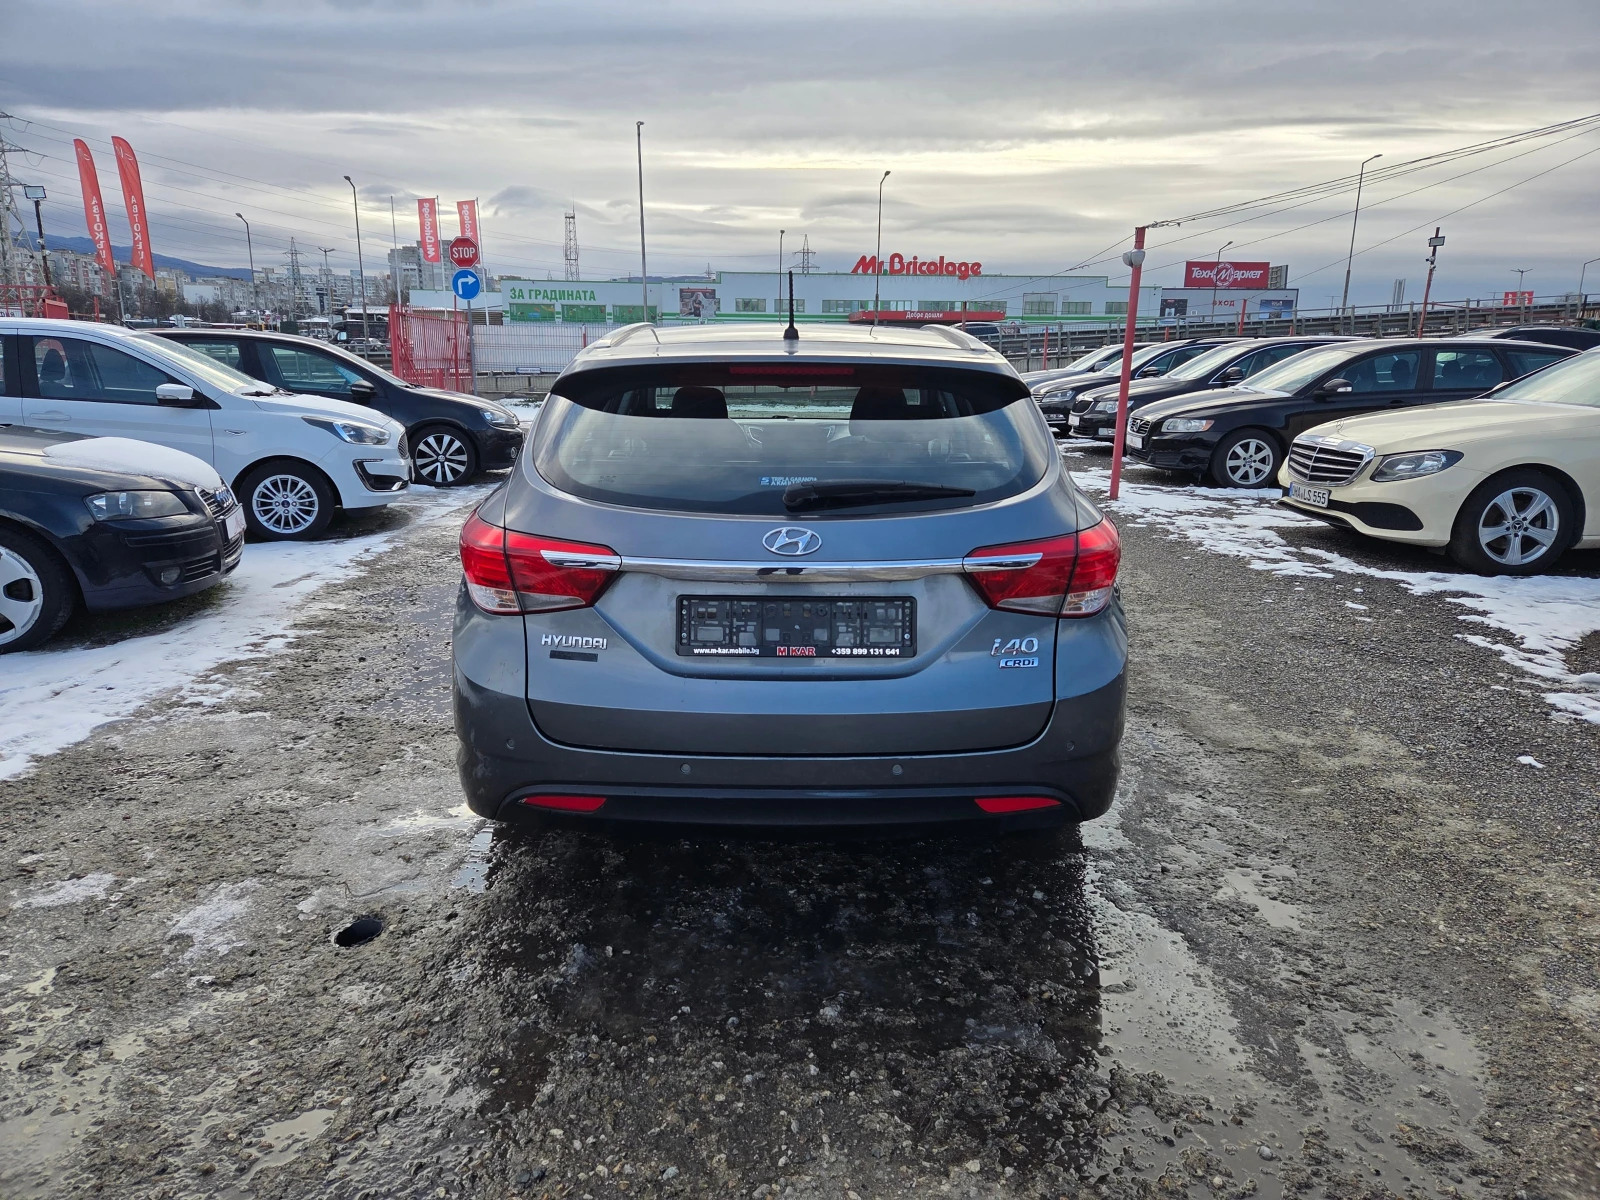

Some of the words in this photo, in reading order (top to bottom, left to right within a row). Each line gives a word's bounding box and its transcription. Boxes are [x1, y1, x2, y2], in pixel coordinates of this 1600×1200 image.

[452, 247, 476, 258] STOP
[509, 288, 525, 300] ЗА
[528, 288, 597, 302] ГРАДИНАТА
[906, 311, 924, 319] Добре
[924, 311, 944, 319] дошли
[1303, 489, 1312, 501] LS
[1313, 491, 1327, 505] 555
[541, 633, 608, 650] HYUNDAI
[991, 637, 1039, 656] i40
[693, 647, 760, 656] www.m-kar.mobile.bg
[776, 646, 787, 656] M
[789, 646, 817, 656] KAR
[1004, 658, 1035, 667] CRDi
